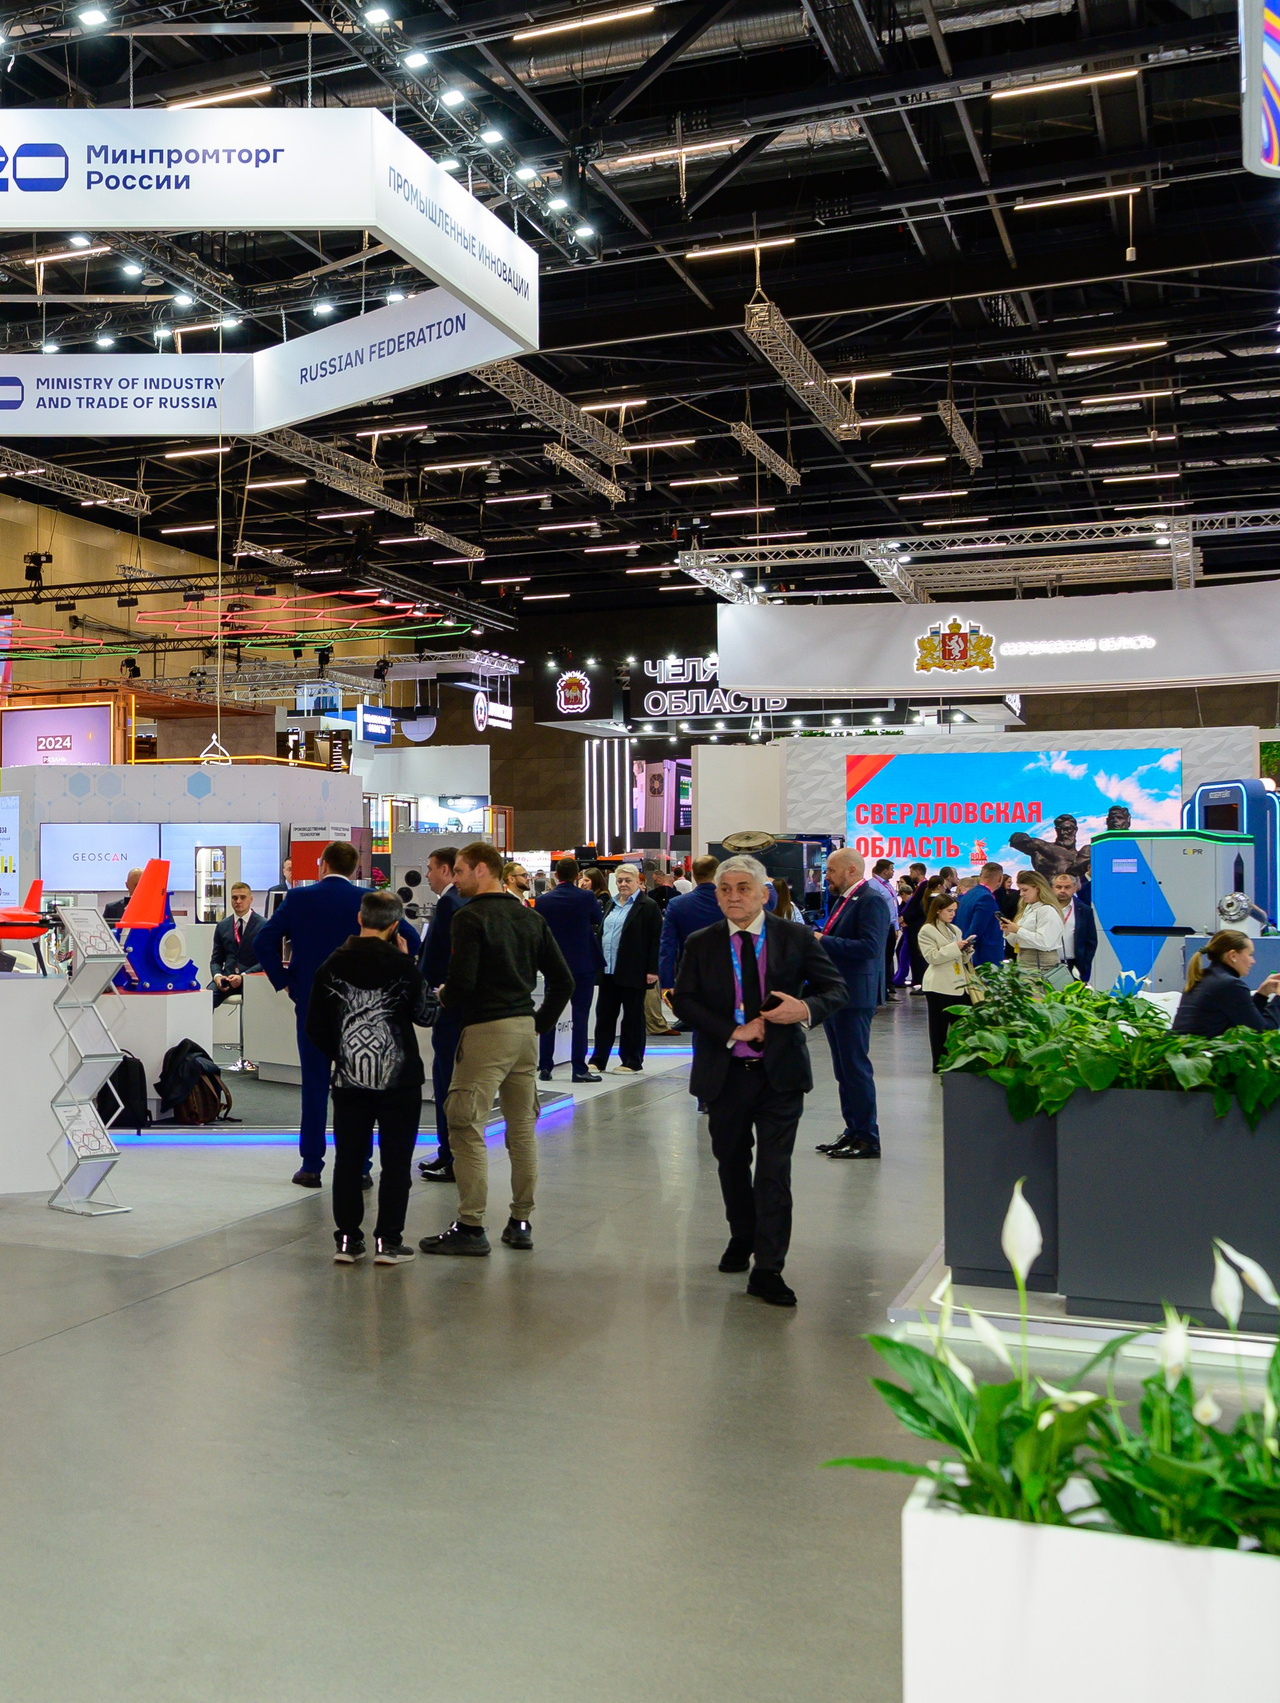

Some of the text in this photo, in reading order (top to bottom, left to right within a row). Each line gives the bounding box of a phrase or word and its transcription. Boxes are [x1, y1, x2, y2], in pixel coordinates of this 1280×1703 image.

[86, 144, 285, 168] Минпромторг
[86, 170, 191, 191] России
[388, 165, 530, 302] ПРОМЫШЛЕННЫЕ ИННОВАЦИИ
[300, 313, 466, 385] RUSSIAN FEDERATION
[36, 377, 225, 390] MINISTRY OF INDUSTRY
[36, 396, 218, 409] AND TRADE OF RUSSIA
[643, 689, 788, 716] ОБЛАСТЬ
[37, 736, 72, 750] 2024
[855, 801, 1042, 828] СВЕРДЛОВСКАЯ
[72, 852, 128, 861] GEOSCAN
[855, 836, 960, 858] ОБЛАСТЬ
